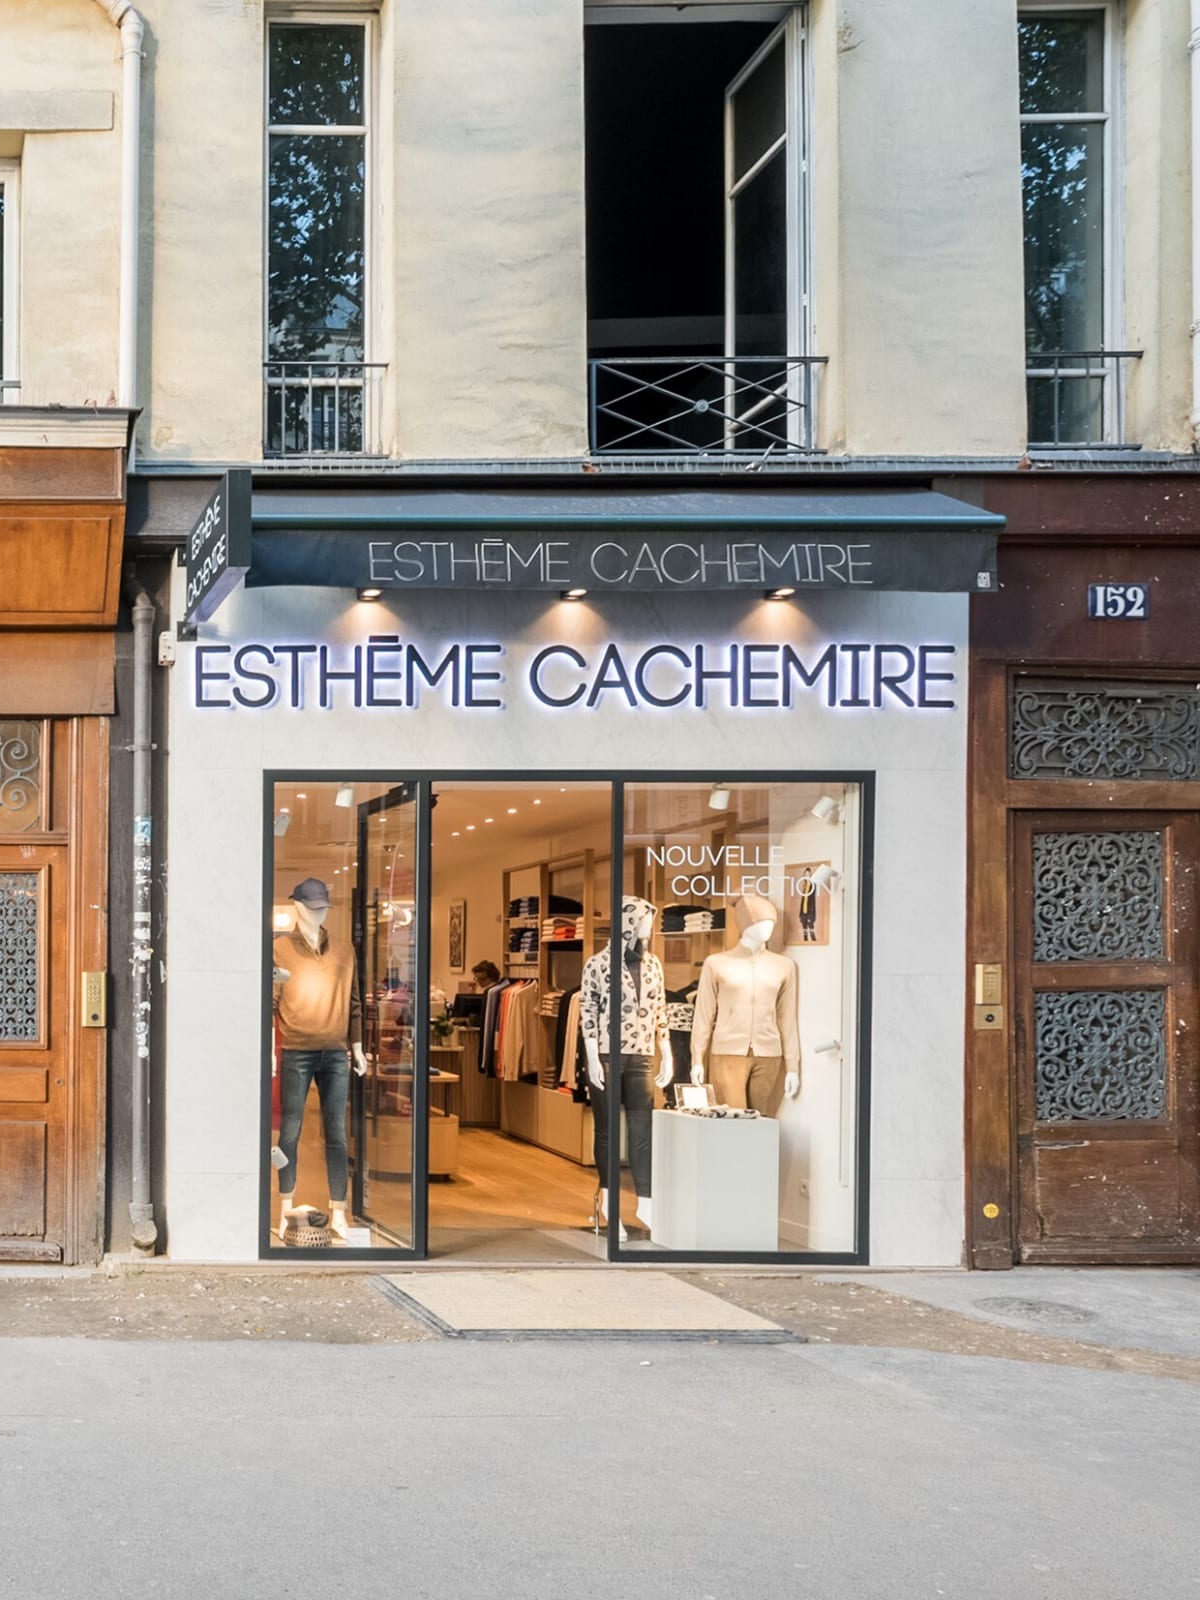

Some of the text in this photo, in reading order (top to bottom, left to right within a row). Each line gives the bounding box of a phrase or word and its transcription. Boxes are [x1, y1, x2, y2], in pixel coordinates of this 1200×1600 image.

[590, 541, 874, 584] CACHEMIRE
[1094, 586, 1145, 617] 152
[528, 643, 956, 708] CACHEMIRE
[646, 846, 785, 867] NOUVELLE
[671, 875, 836, 897] COLLECTION
